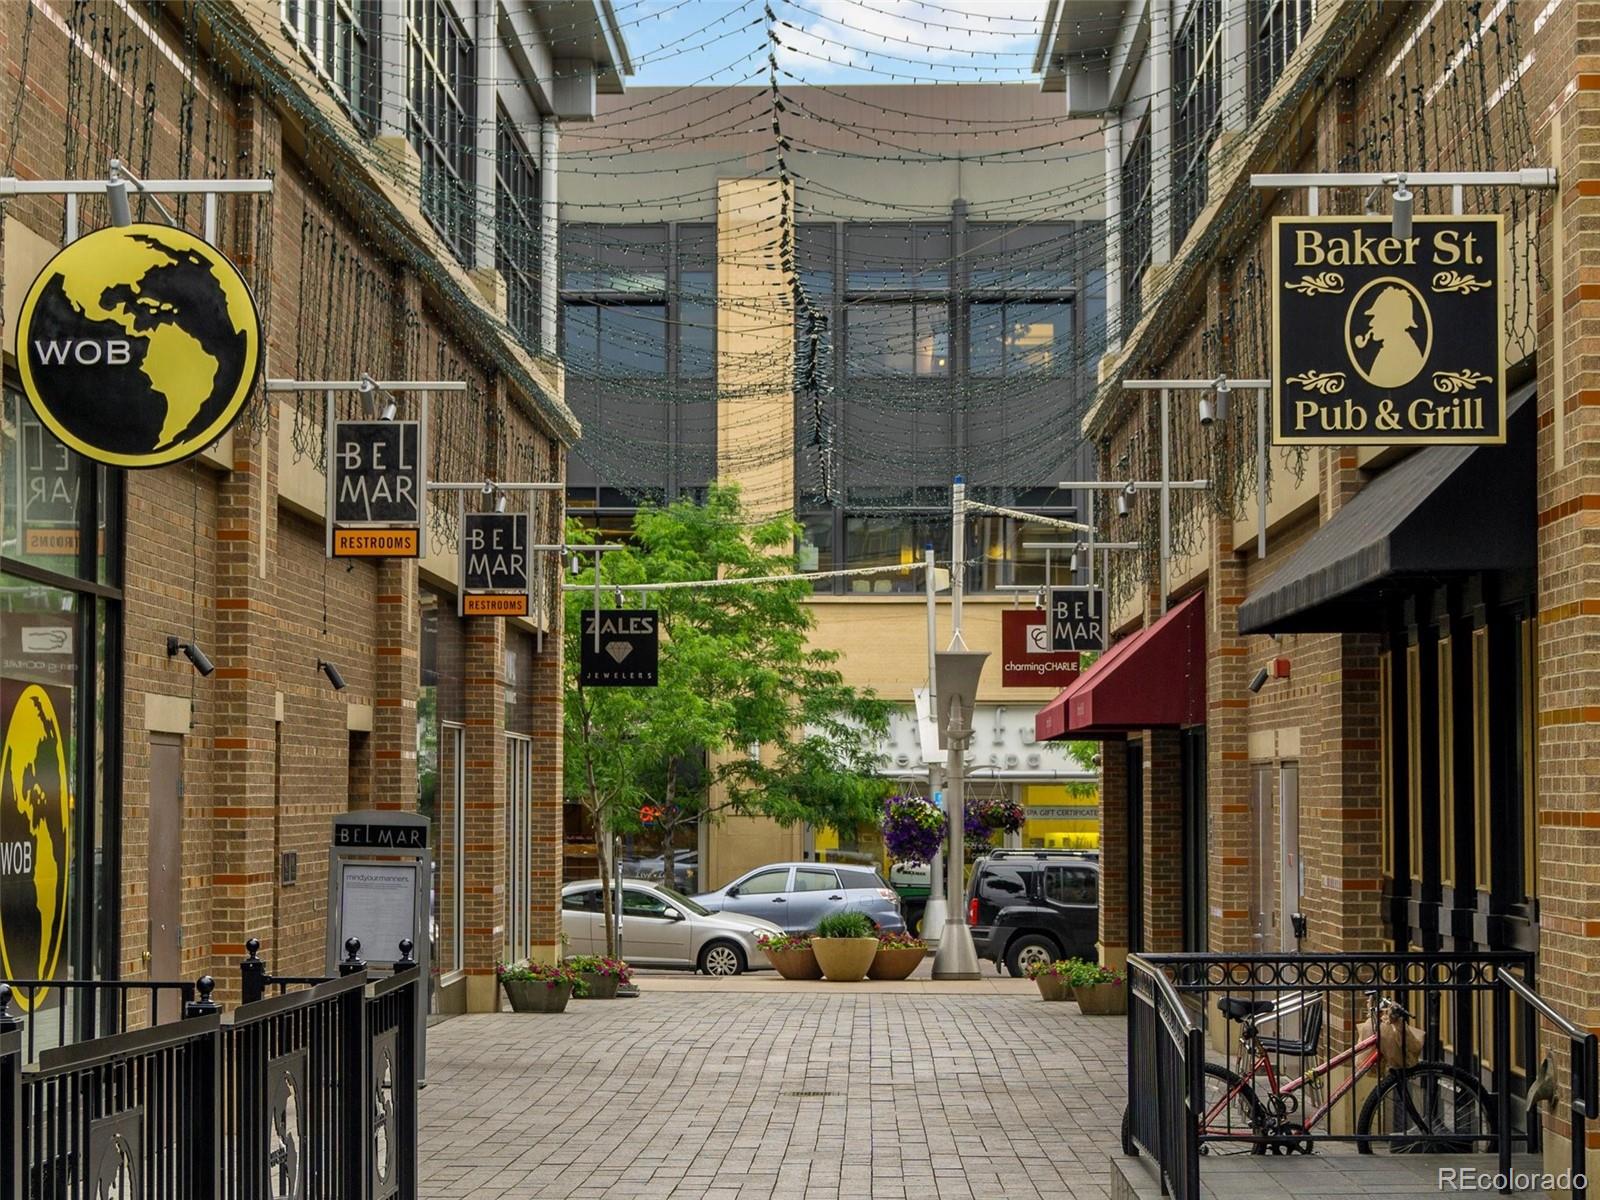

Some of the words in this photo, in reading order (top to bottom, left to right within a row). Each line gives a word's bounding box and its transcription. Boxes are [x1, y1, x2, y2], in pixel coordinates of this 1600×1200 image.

[1294, 229, 1420, 266] Baker
[1432, 230, 1484, 265] St.
[35, 340, 131, 365] WOB
[1295, 399, 1367, 431] Pub
[1375, 400, 1402, 430] &
[1408, 398, 1484, 430] Grill
[344, 423, 412, 470] BEL
[340, 477, 417, 521] MAR
[340, 535, 412, 549] RESTROOMS
[472, 515, 523, 550] BEL
[468, 554, 527, 588] MAR
[468, 600, 523, 610] RESTROOMS
[586, 617, 653, 635] ZALES
[1055, 622, 1103, 650] MAR
[586, 672, 653, 680] JEWELERS
[1005, 661, 1078, 675] charmingCHARLIE
[1040, 809, 1055, 817] GIFT
[0, 841, 32, 876] WOB
